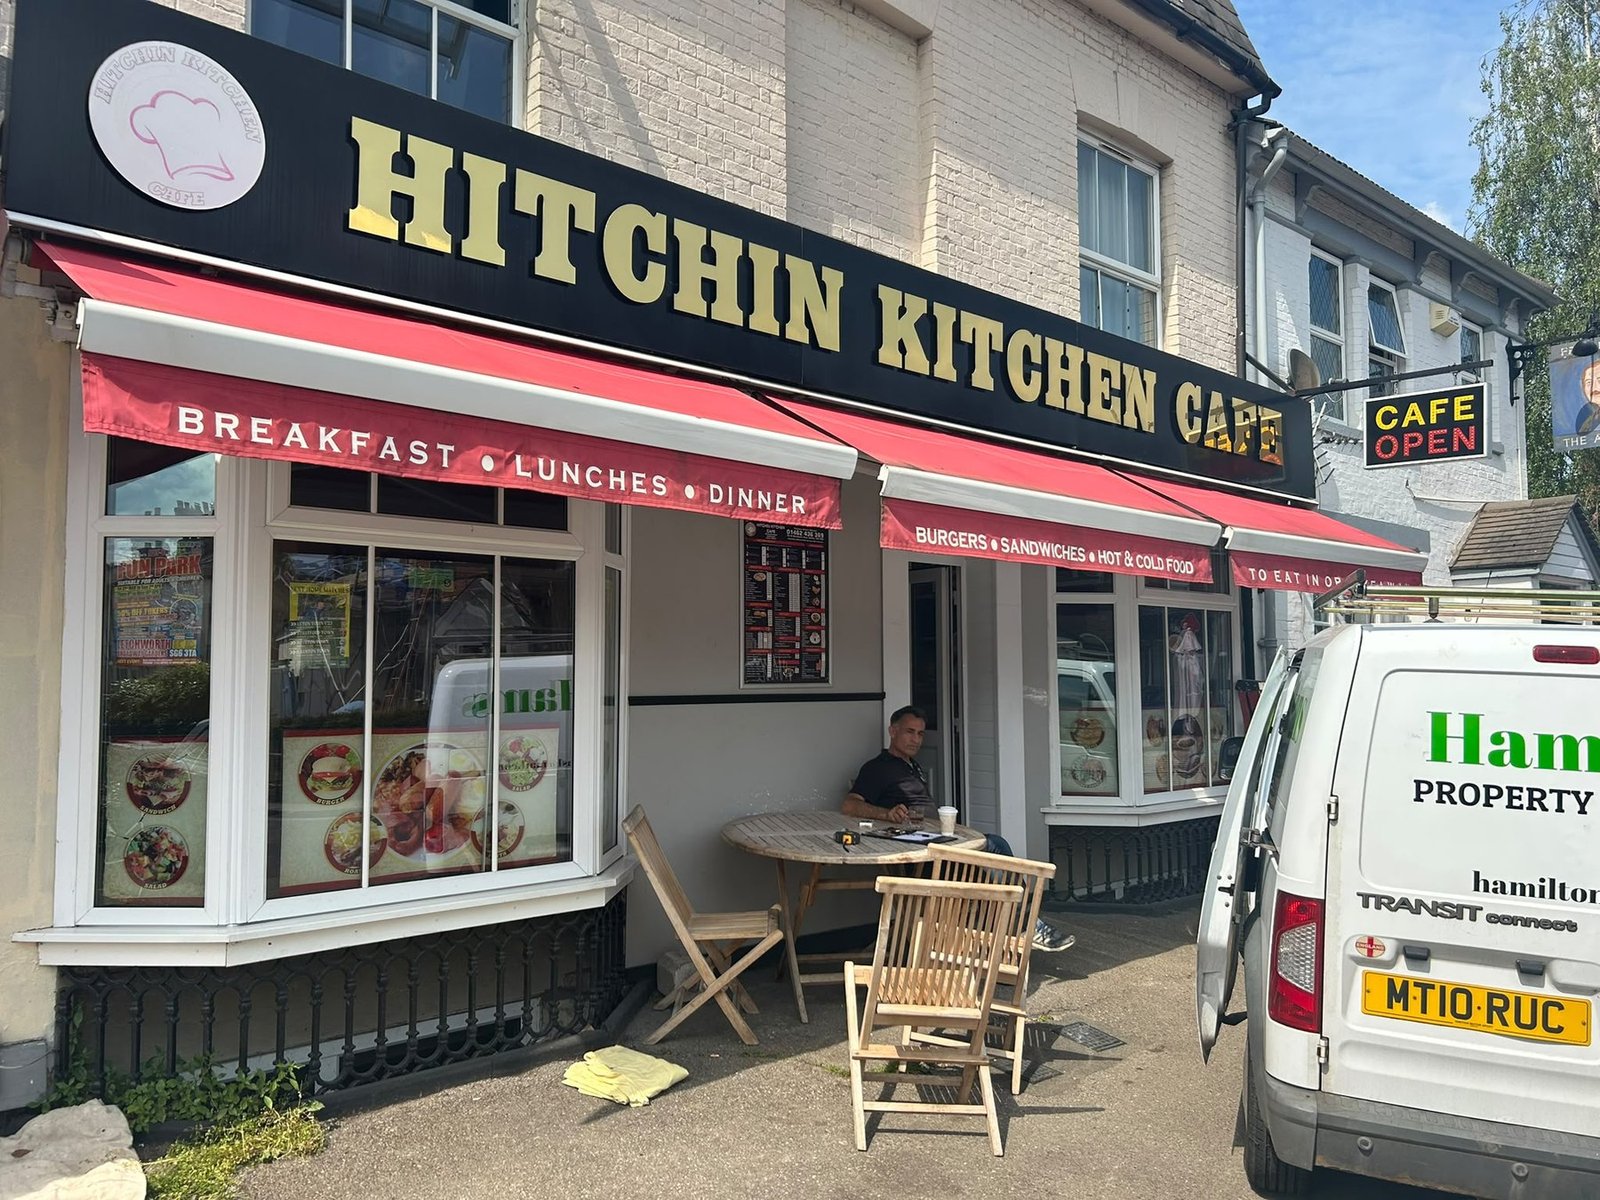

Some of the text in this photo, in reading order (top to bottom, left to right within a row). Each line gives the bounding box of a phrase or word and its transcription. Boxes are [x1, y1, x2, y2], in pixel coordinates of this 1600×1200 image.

[94, 46, 262, 144] HITCHIN KITCHEN
[148, 181, 205, 206] CAFE
[348, 115, 1283, 466] HITCHIN KITCHEN CAFE
[1375, 394, 1475, 431] CAFE
[177, 405, 806, 514] BREAKFAST LUNCHES DINNER
[1374, 425, 1476, 460] OPEN
[1562, 436, 1588, 448] THE
[117, 555, 201, 579] FUN PARK
[915, 526, 1194, 575] BURGERS SANDWICHES HOT & COLD FOOD
[1248, 568, 1267, 582] TO
[1274, 570, 1300, 584] EAT
[1306, 574, 1320, 587] IN
[169, 649, 182, 657] SG6
[183, 649, 197, 657] 3TA
[1426, 710, 1600, 773] Ham
[316, 796, 345, 806] BURGER
[512, 784, 531, 792] SALAD
[1413, 779, 1594, 815] PROPERTY
[140, 804, 177, 815] SANDWICH
[1356, 891, 1578, 933] TRANSIT connect
[1356, 941, 1385, 951] ENGLAND
[1386, 977, 1565, 1034] MT10 RUC
